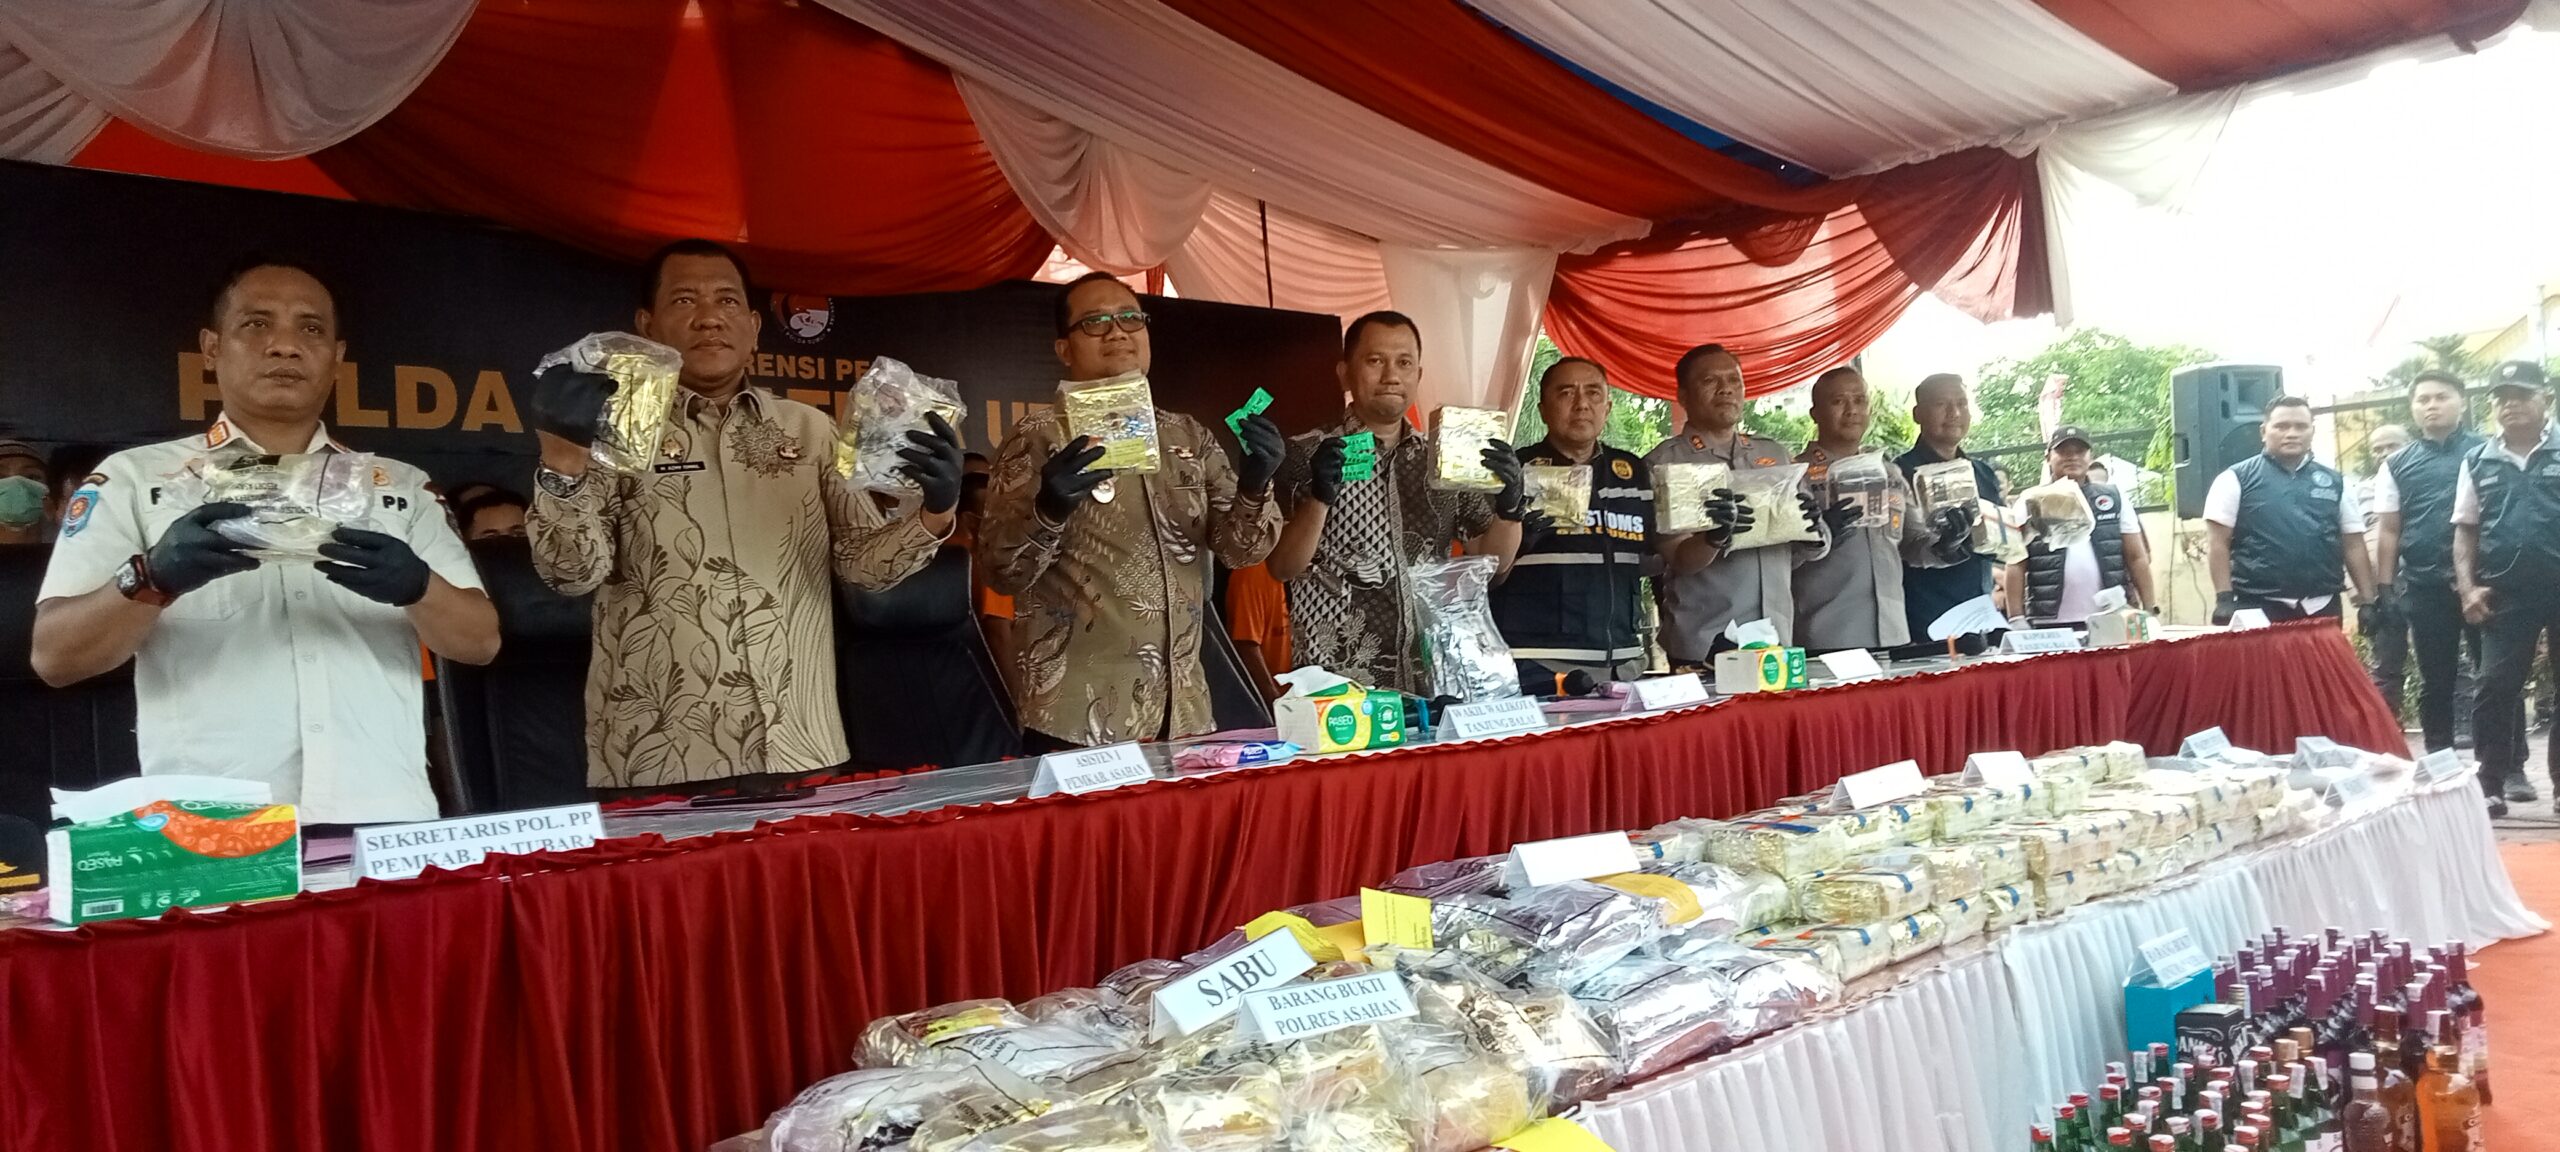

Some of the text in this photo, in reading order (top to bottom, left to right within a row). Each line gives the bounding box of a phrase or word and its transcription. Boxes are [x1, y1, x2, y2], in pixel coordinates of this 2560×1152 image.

[744, 353, 871, 382] RENSI PE
[177, 352, 524, 433] PLDA
[1328, 714, 1354, 727] PASEO
[366, 810, 594, 852] SEKRETARIS POL. PP
[77, 855, 124, 872] PASEO
[370, 849, 478, 876] PEMKAB.
[1197, 948, 1279, 1008] SABU
[1267, 976, 1388, 1011] BARANG BUKTI
[1276, 998, 1404, 1037] POLRES ASAHAN
